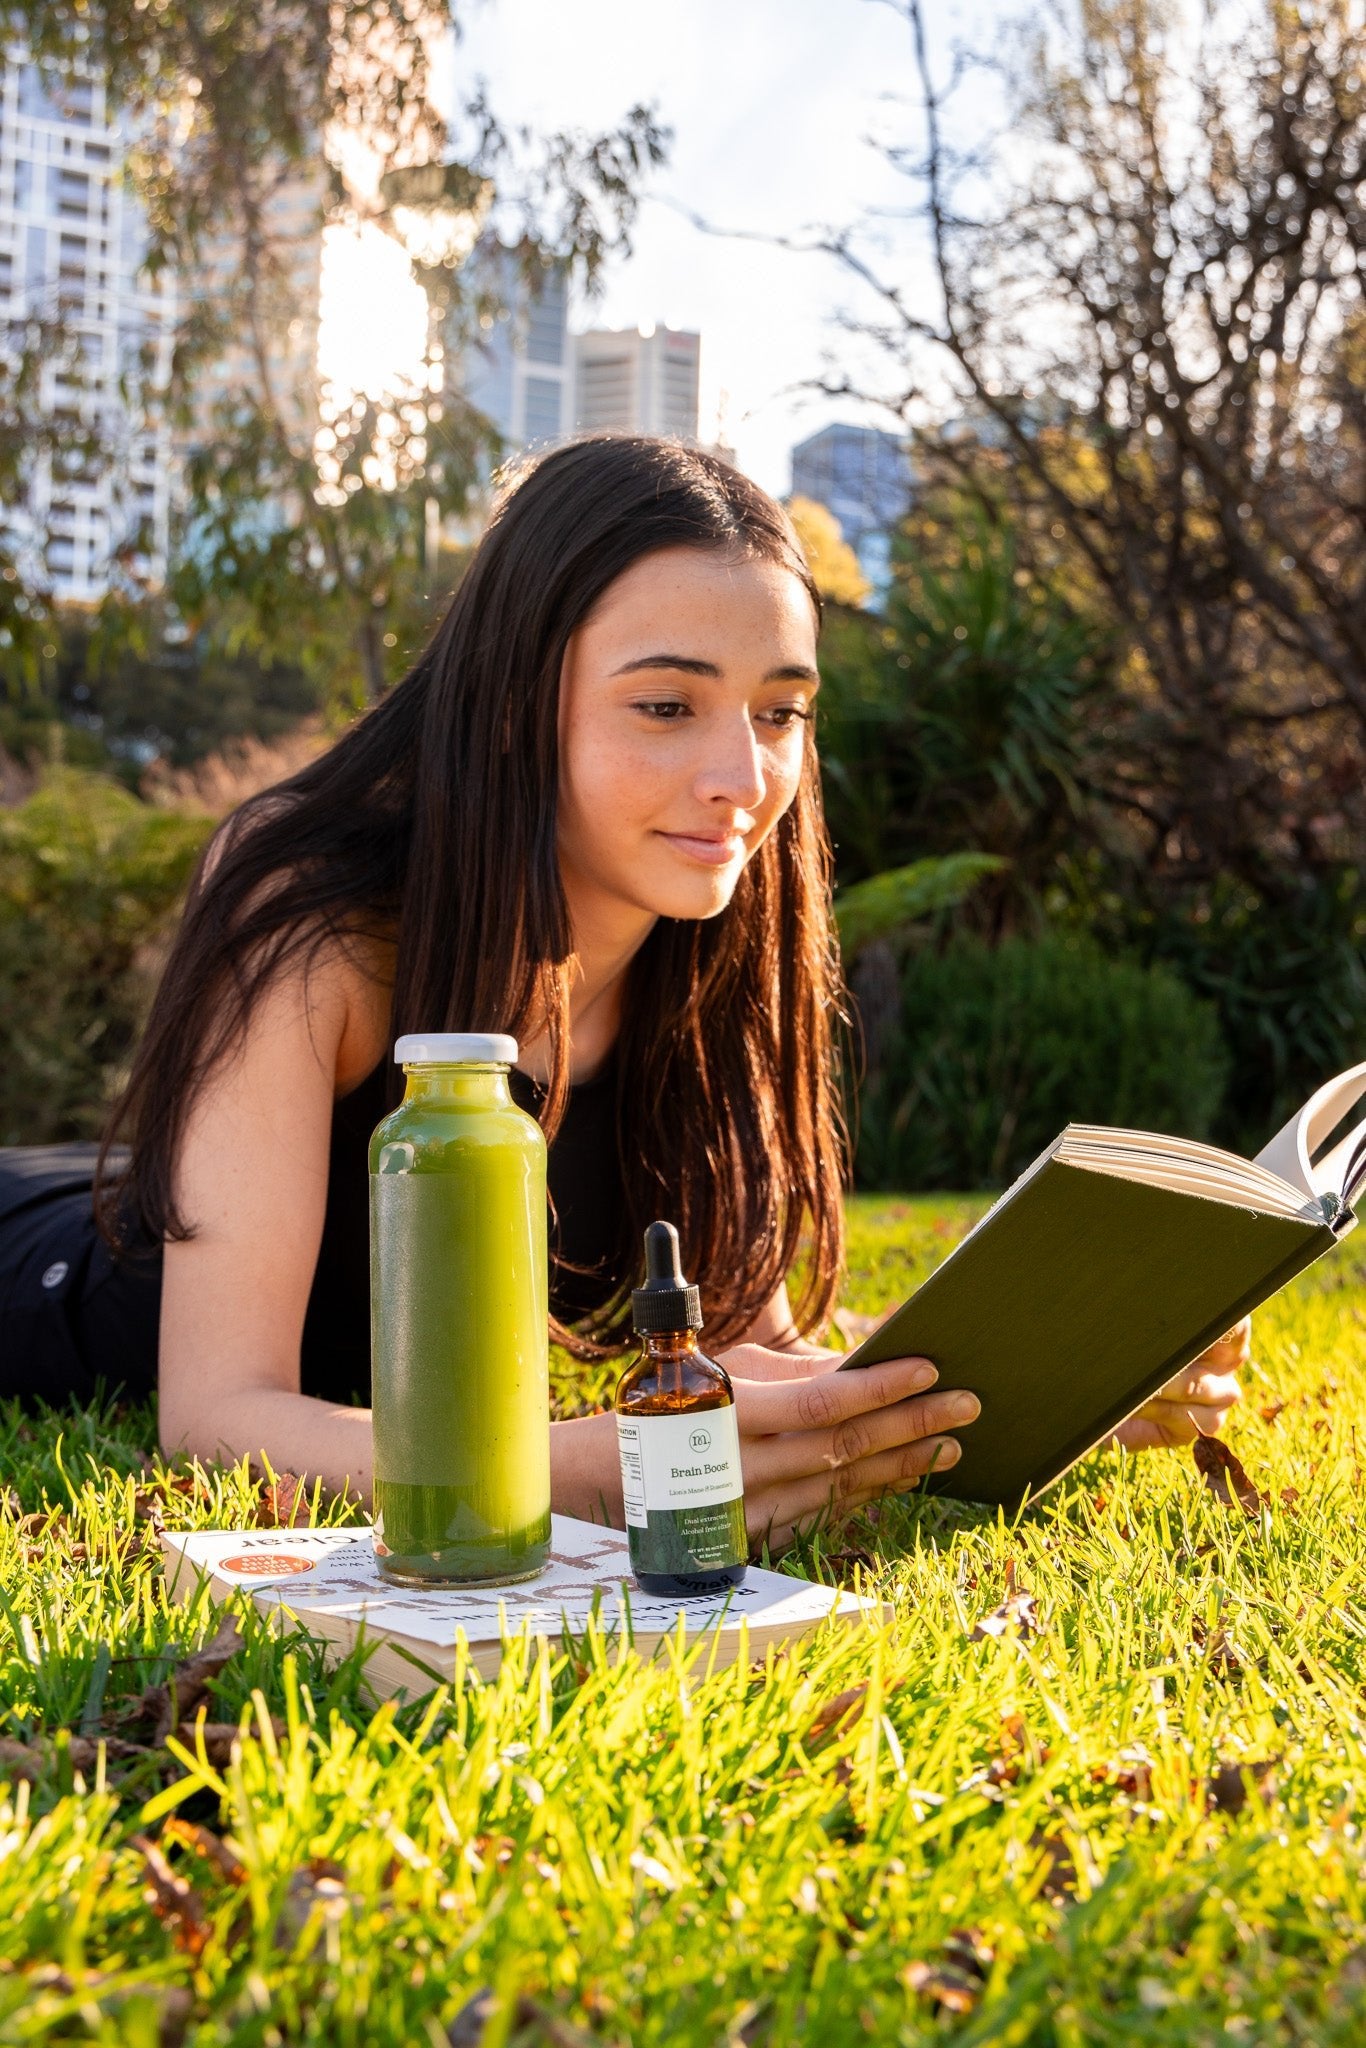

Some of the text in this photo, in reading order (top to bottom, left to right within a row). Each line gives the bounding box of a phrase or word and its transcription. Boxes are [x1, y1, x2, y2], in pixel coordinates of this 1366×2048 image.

[670, 1461, 729, 1478] Brain Boost
[687, 1487, 704, 1495] Mane
[684, 1511, 728, 1525] Dual extracted
[680, 1521, 732, 1536] Alcohol free elixir
[241, 1536, 358, 1548] Clear
